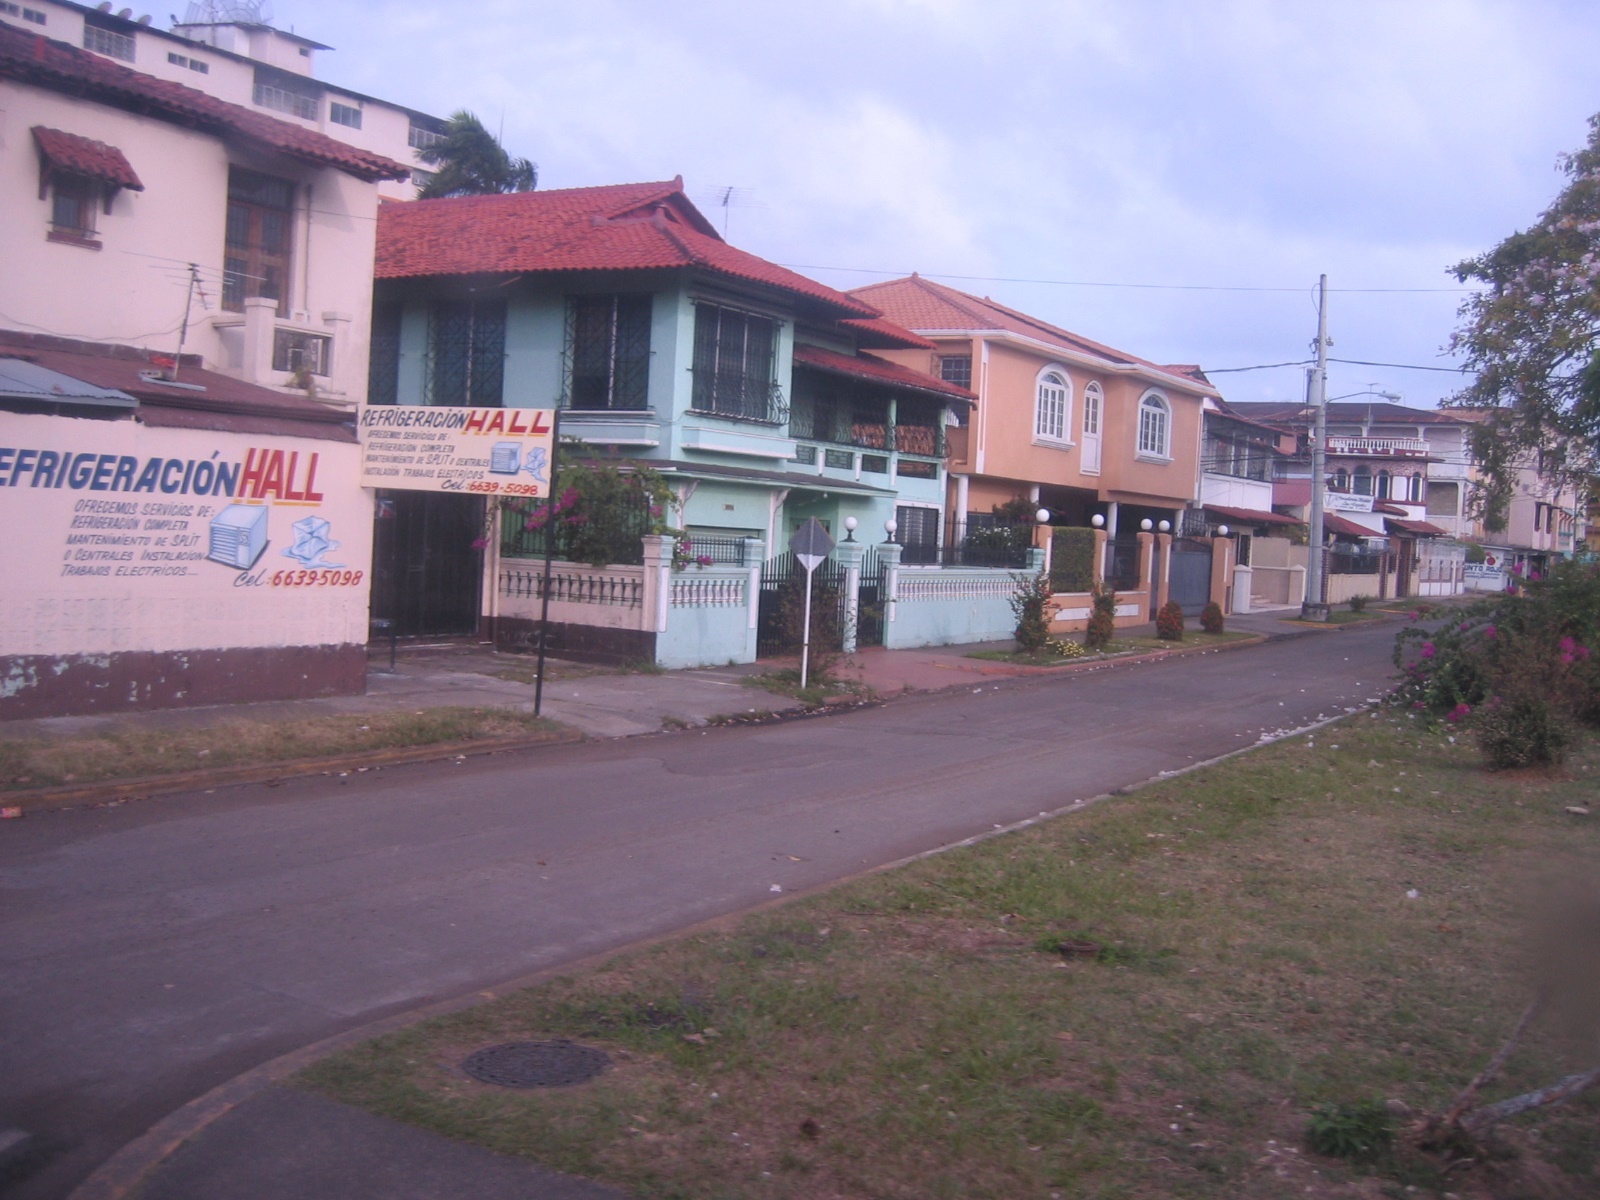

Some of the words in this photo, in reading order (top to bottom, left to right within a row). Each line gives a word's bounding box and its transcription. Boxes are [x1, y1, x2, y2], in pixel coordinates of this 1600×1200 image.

[361, 407, 469, 429] REFRIGERACIÓN
[464, 410, 551, 437] HALL
[420, 444, 456, 453] COMPLETA
[425, 453, 450, 465] SPLIT
[239, 447, 324, 503] HALL
[74, 499, 138, 515] OFRECEMOS
[140, 501, 194, 517] SERVICIOS
[144, 518, 190, 531] COMPLETA
[65, 533, 151, 546] MANTENIMIENTO
[154, 537, 169, 546] DE
[170, 532, 201, 547] SPLIT
[74, 548, 134, 561] CENTRALES
[61, 564, 112, 577] TRABAJOS
[271, 569, 364, 588] 6639-5098
